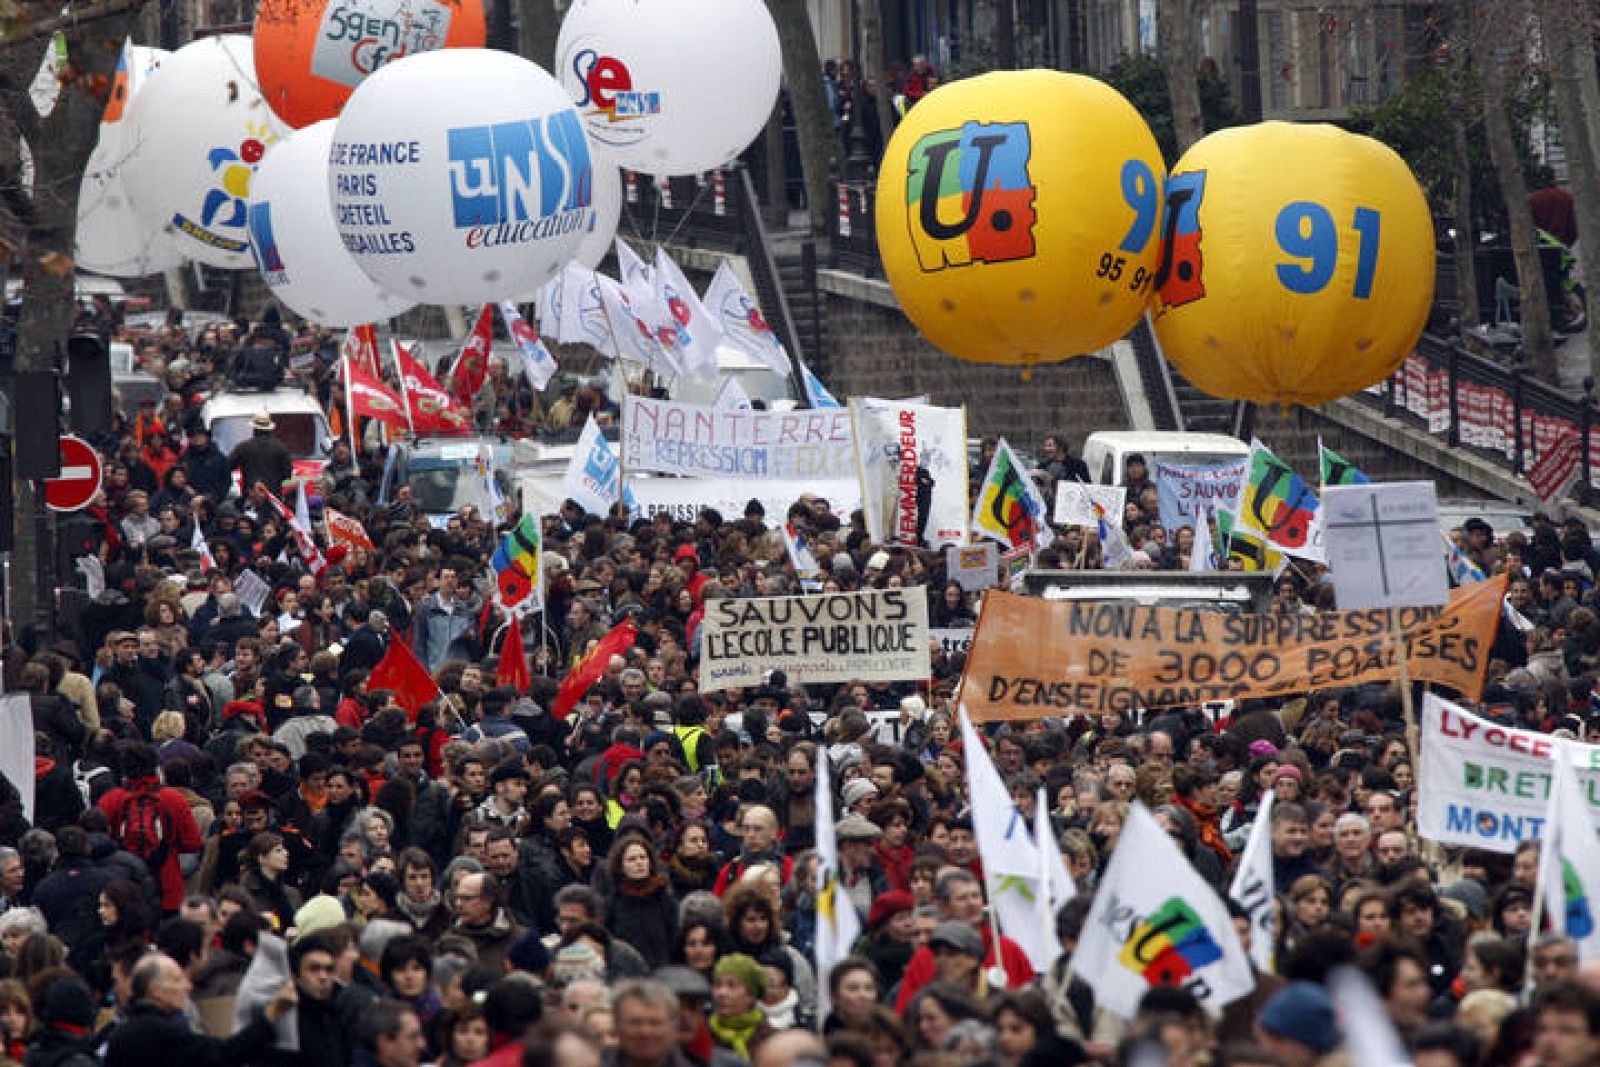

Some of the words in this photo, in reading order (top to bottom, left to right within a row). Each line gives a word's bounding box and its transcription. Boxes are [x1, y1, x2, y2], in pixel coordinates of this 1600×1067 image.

[349, 141, 420, 165] FRANCE
[337, 173, 377, 196] PARIS
[1096, 252, 1126, 281] 95
[1275, 201, 1380, 298] 91
[633, 401, 850, 446] NANTERRE
[719, 591, 908, 628] SAUVONS
[1069, 602, 1137, 640] NON
[1175, 610, 1207, 643] LA
[801, 622, 917, 656] PUBLIQUE
[1088, 649, 1131, 677] DE
[1154, 650, 1280, 684] 3000
[1439, 709, 1553, 758] LYCEE
